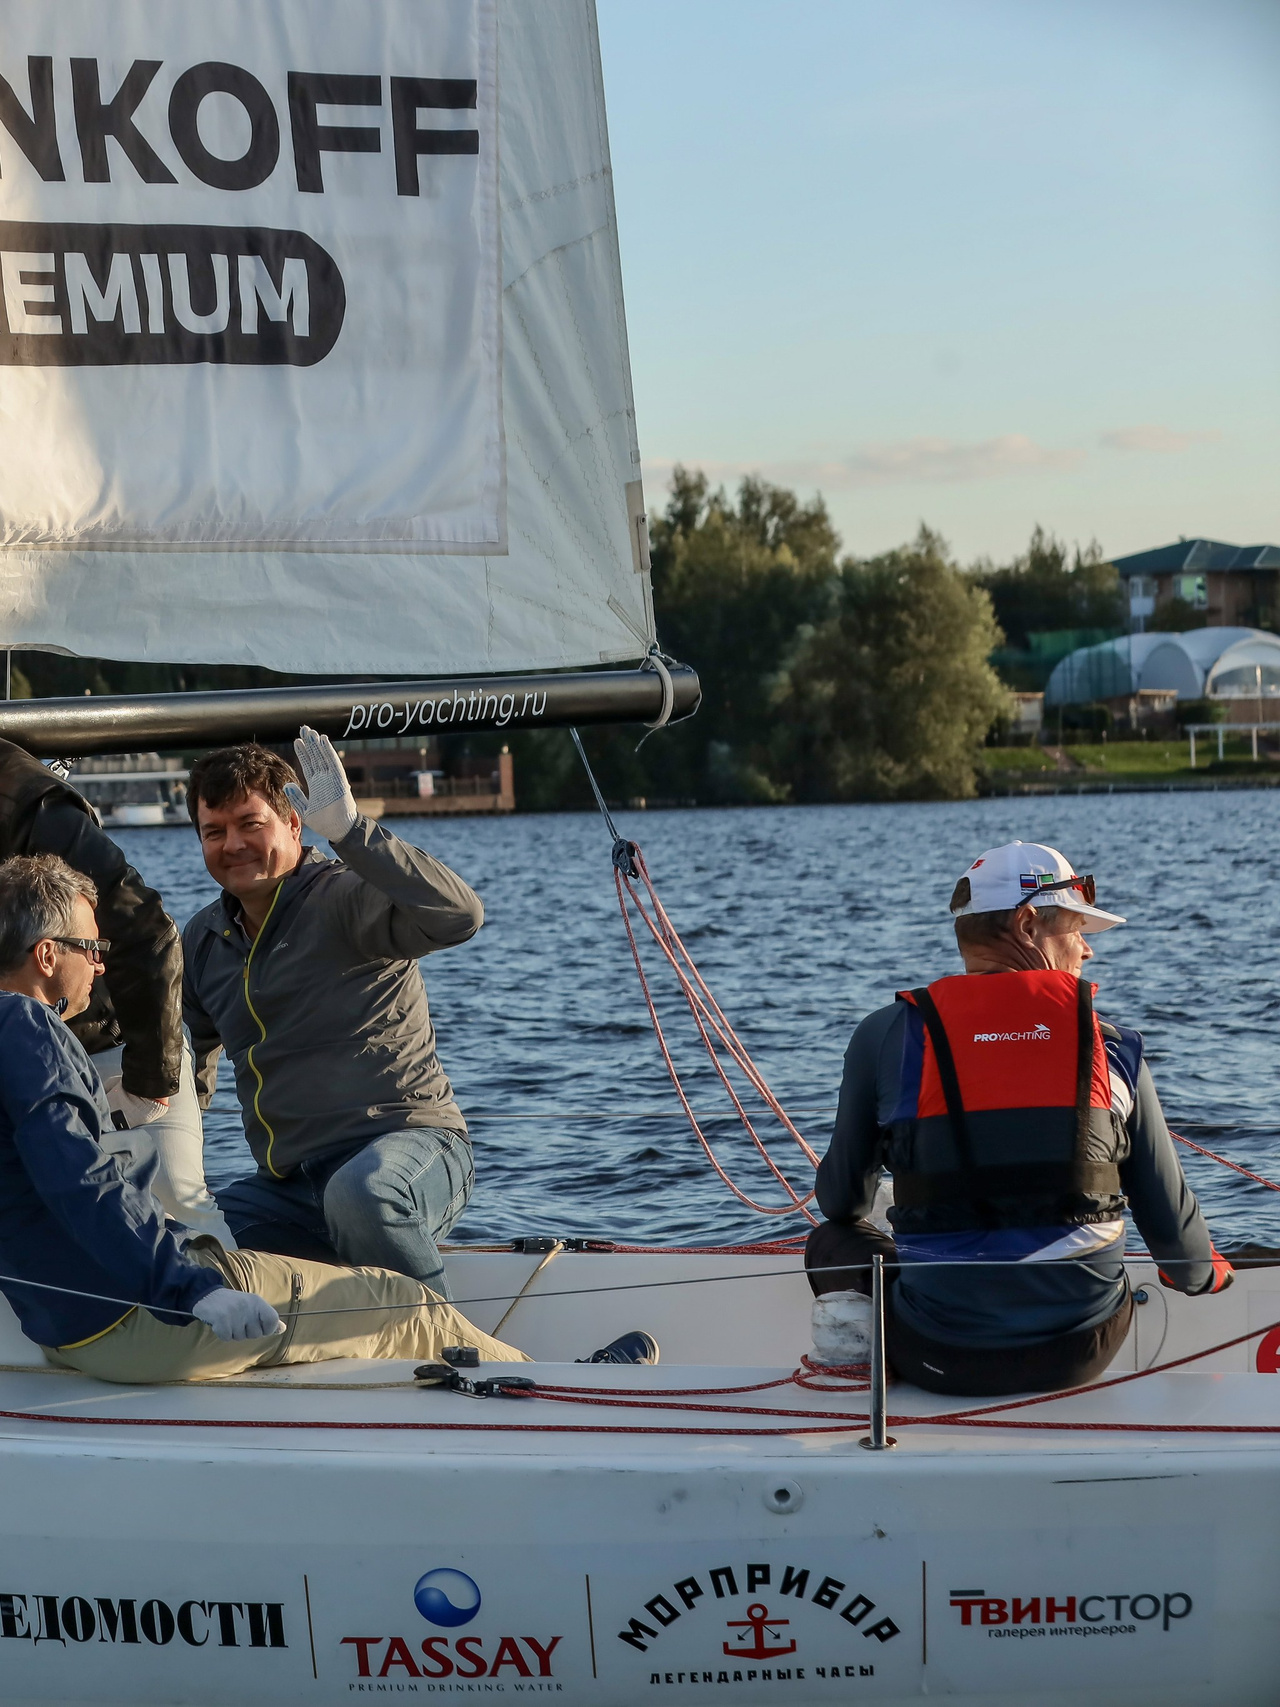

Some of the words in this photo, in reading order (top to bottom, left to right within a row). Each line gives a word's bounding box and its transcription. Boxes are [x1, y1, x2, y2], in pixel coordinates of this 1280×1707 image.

[343, 687, 548, 738] pro-yachting.ru
[973, 1032, 1051, 1042] PROYACHTING
[617, 1563, 901, 1653] МОРПРИБОР
[988, 1626, 1045, 1640] галерея
[1049, 1623, 1137, 1638] интерьеров
[340, 1636, 564, 1678] TASSAY
[649, 1667, 805, 1685] ЛЕГЕНДАРНЫЕ
[816, 1664, 875, 1678] ЧАСЫ
[348, 1683, 418, 1692] PREMIUM
[427, 1683, 505, 1692] DRINKING
[514, 1683, 564, 1692] WATER
